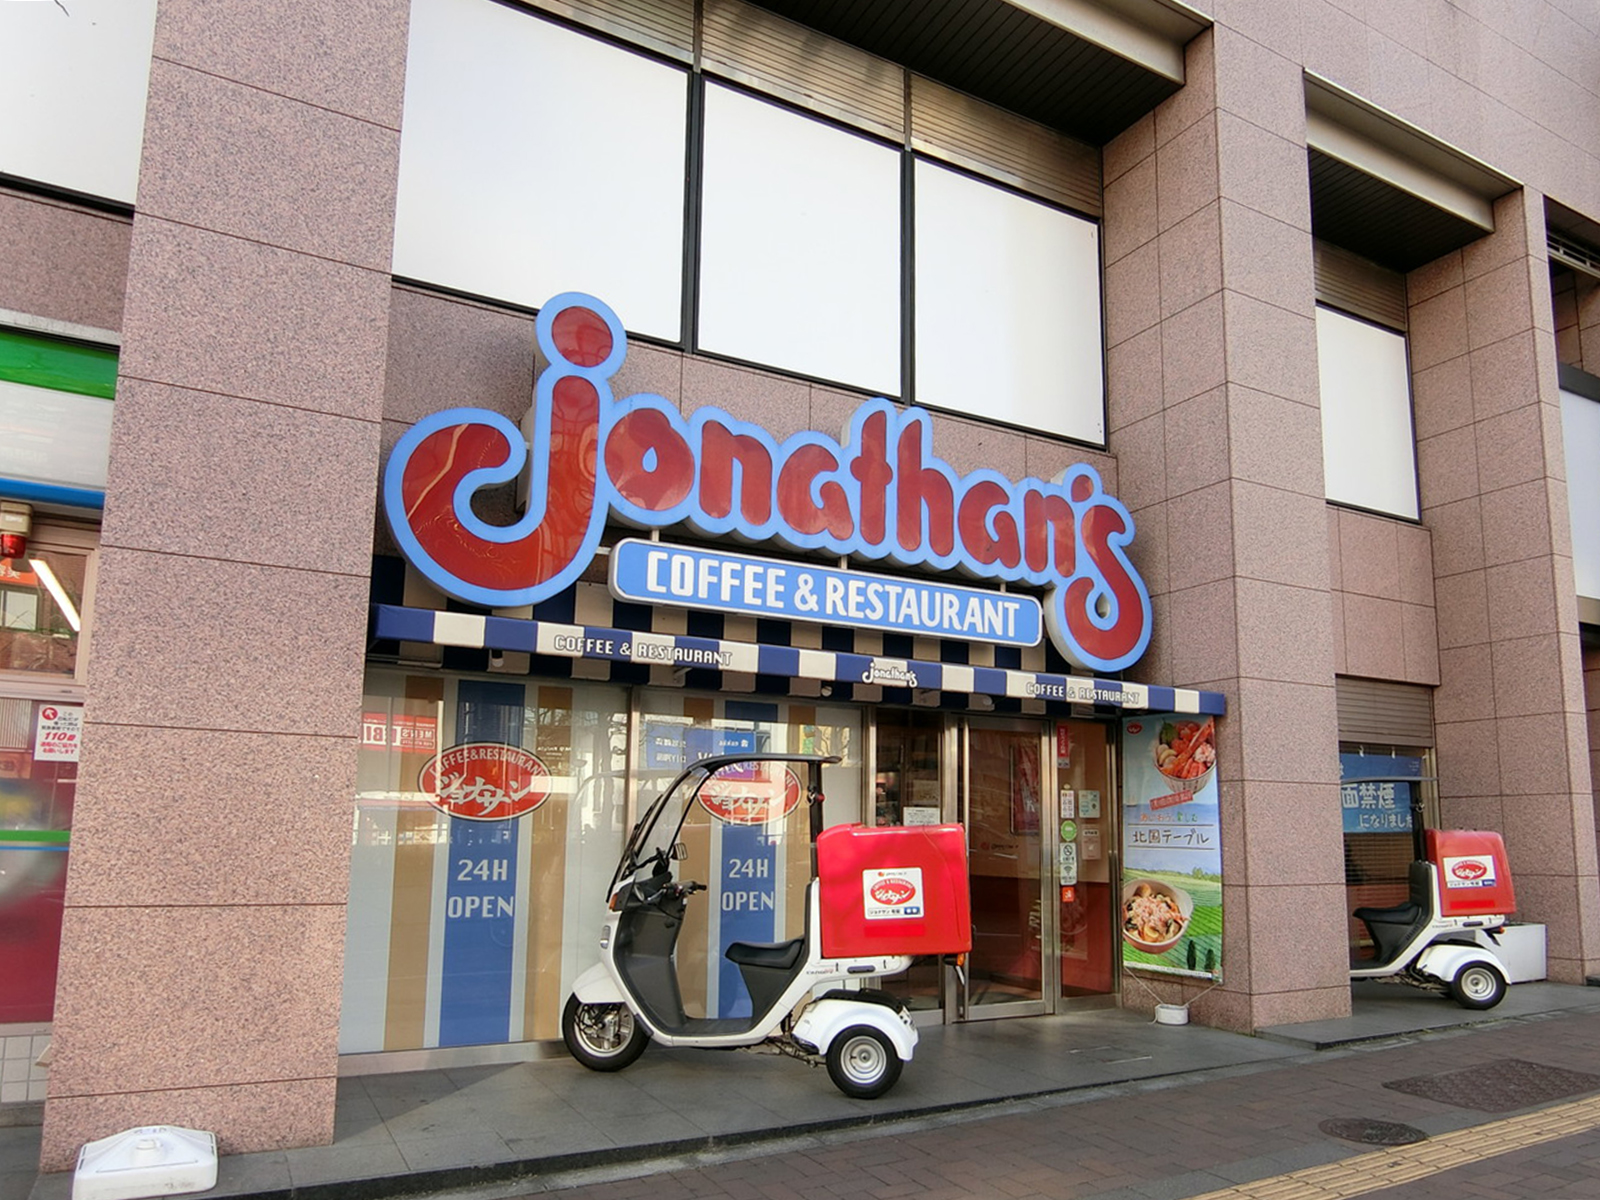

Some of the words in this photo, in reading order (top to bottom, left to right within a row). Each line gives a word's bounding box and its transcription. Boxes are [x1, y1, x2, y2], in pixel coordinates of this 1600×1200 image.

[646, 551, 786, 608] COFFEE
[794, 573, 819, 612] &
[825, 577, 1020, 638] RESTAURANT
[554, 635, 614, 655] COFFEE
[619, 642, 632, 655] &
[637, 642, 733, 666] RESTAURANT
[1026, 682, 1064, 697] COFFEE
[1067, 687, 1076, 698] &
[1078, 687, 1140, 704] RESTAURANT
[1359, 814, 1413, 829] になりました
[1132, 828, 1210, 846] 北国テーブル
[457, 859, 508, 881] 24H
[728, 858, 769, 878] 24H
[447, 895, 514, 918] OPEN
[721, 890, 775, 911] OPEN
